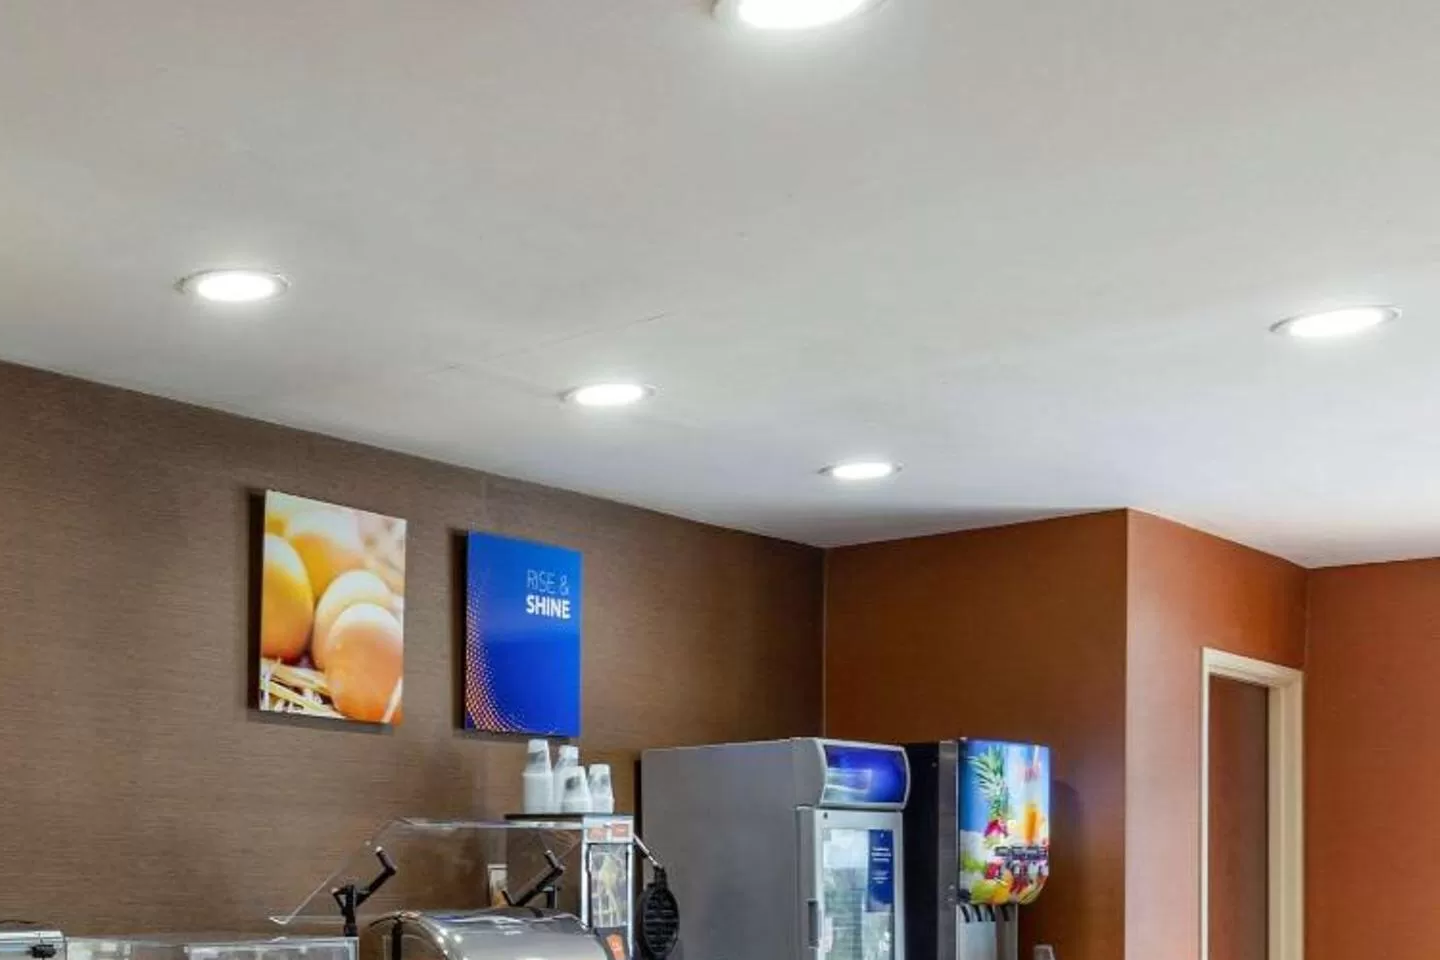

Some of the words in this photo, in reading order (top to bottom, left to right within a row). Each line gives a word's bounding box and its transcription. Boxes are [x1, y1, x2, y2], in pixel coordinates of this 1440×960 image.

[527, 569, 556, 594] RISE
[559, 575, 569, 596] &
[526, 594, 571, 619] SHINE
